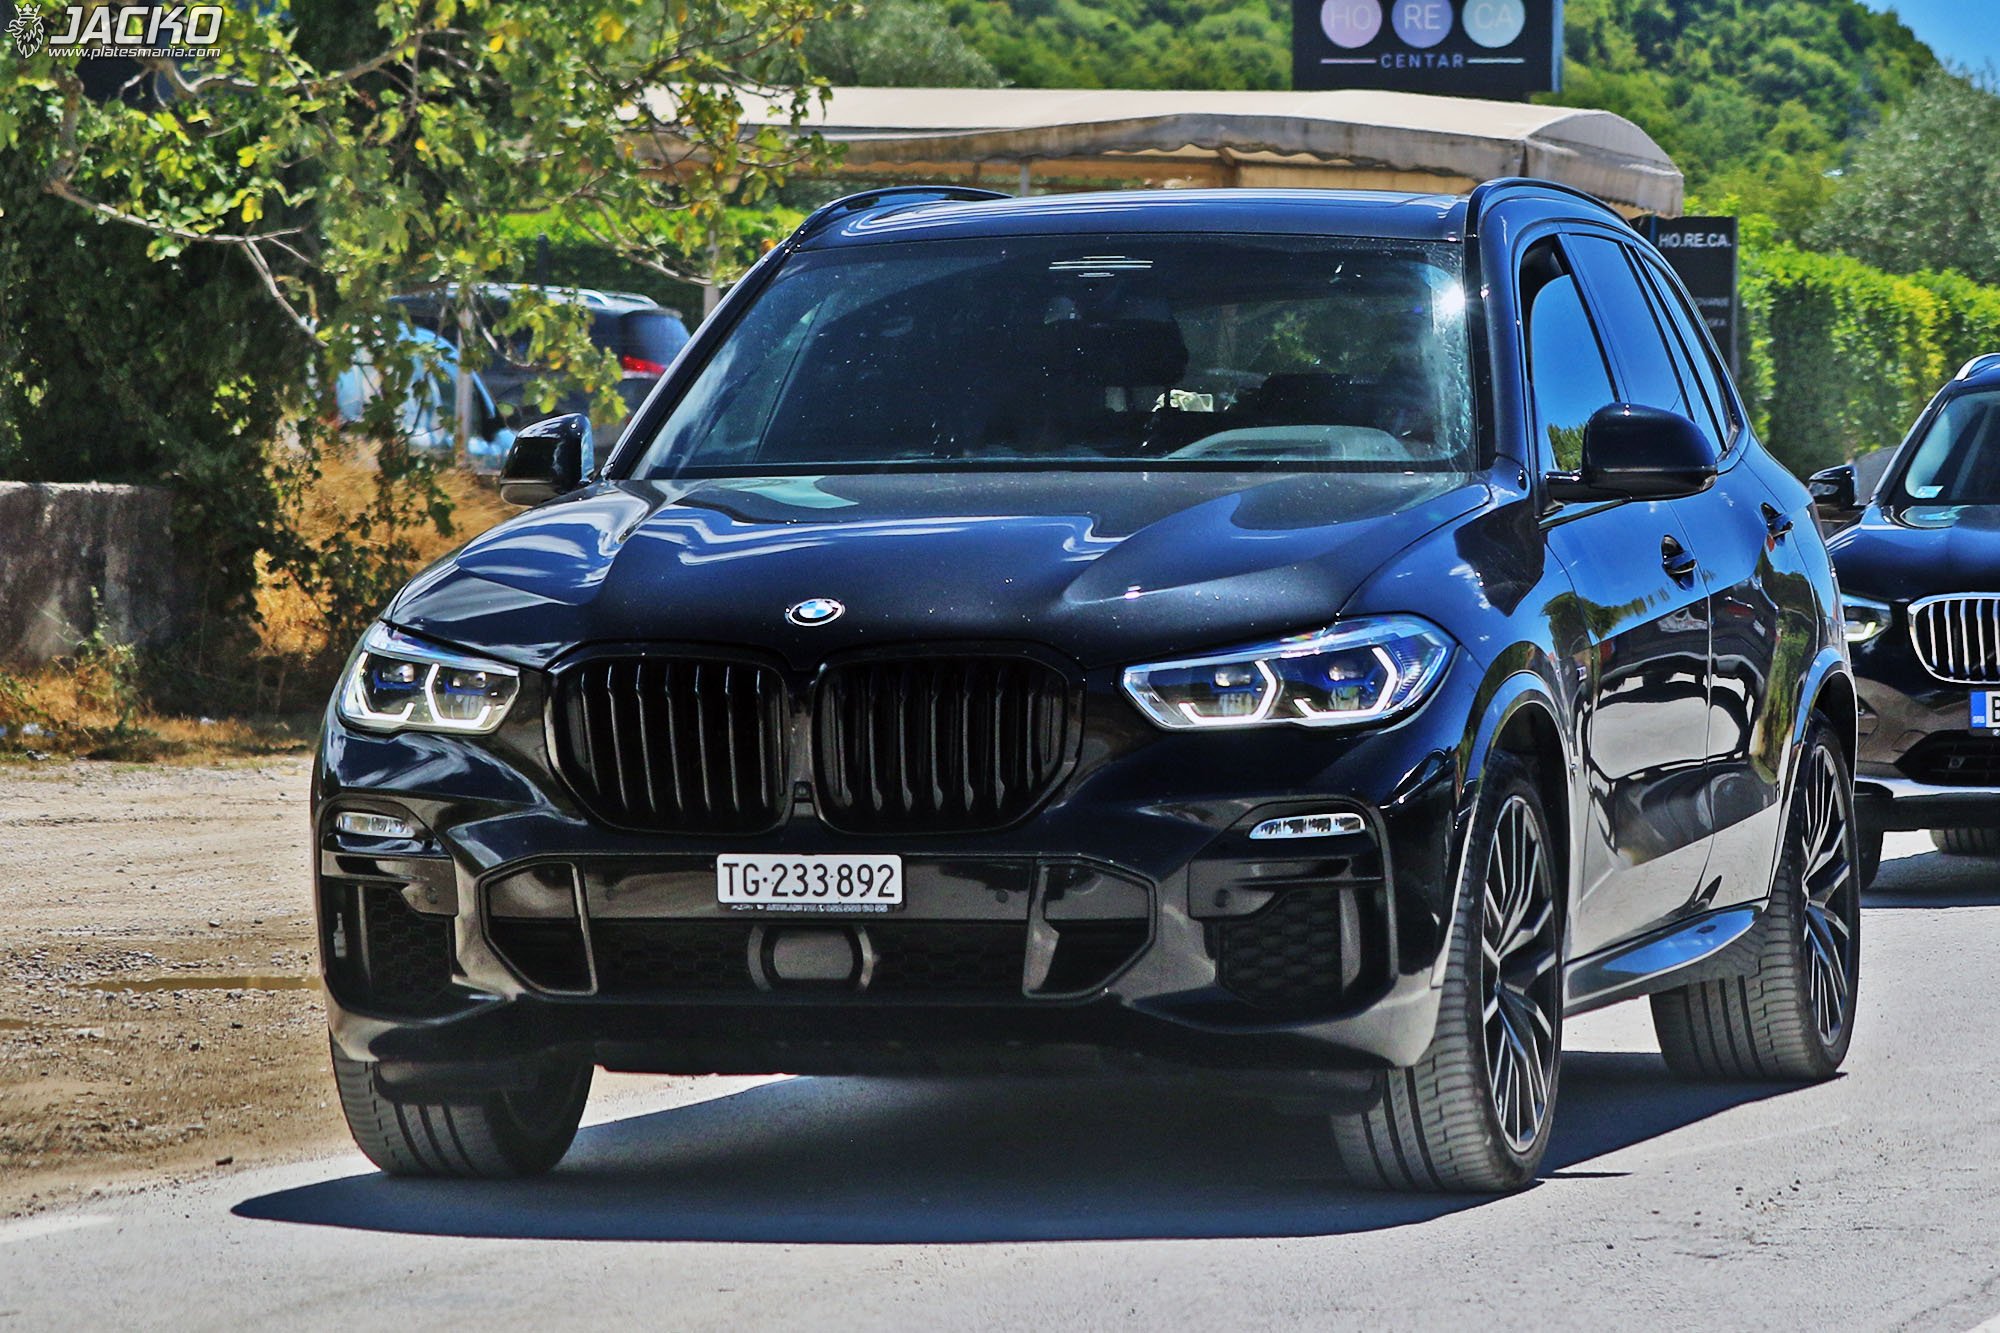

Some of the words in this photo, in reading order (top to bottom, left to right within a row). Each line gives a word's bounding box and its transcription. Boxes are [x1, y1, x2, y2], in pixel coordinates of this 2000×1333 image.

[1331, 5, 1371, 31] HO
[1404, 4, 1441, 30] RE
[1474, 4, 1513, 30] CA
[1380, 53, 1464, 69] CENTAR
